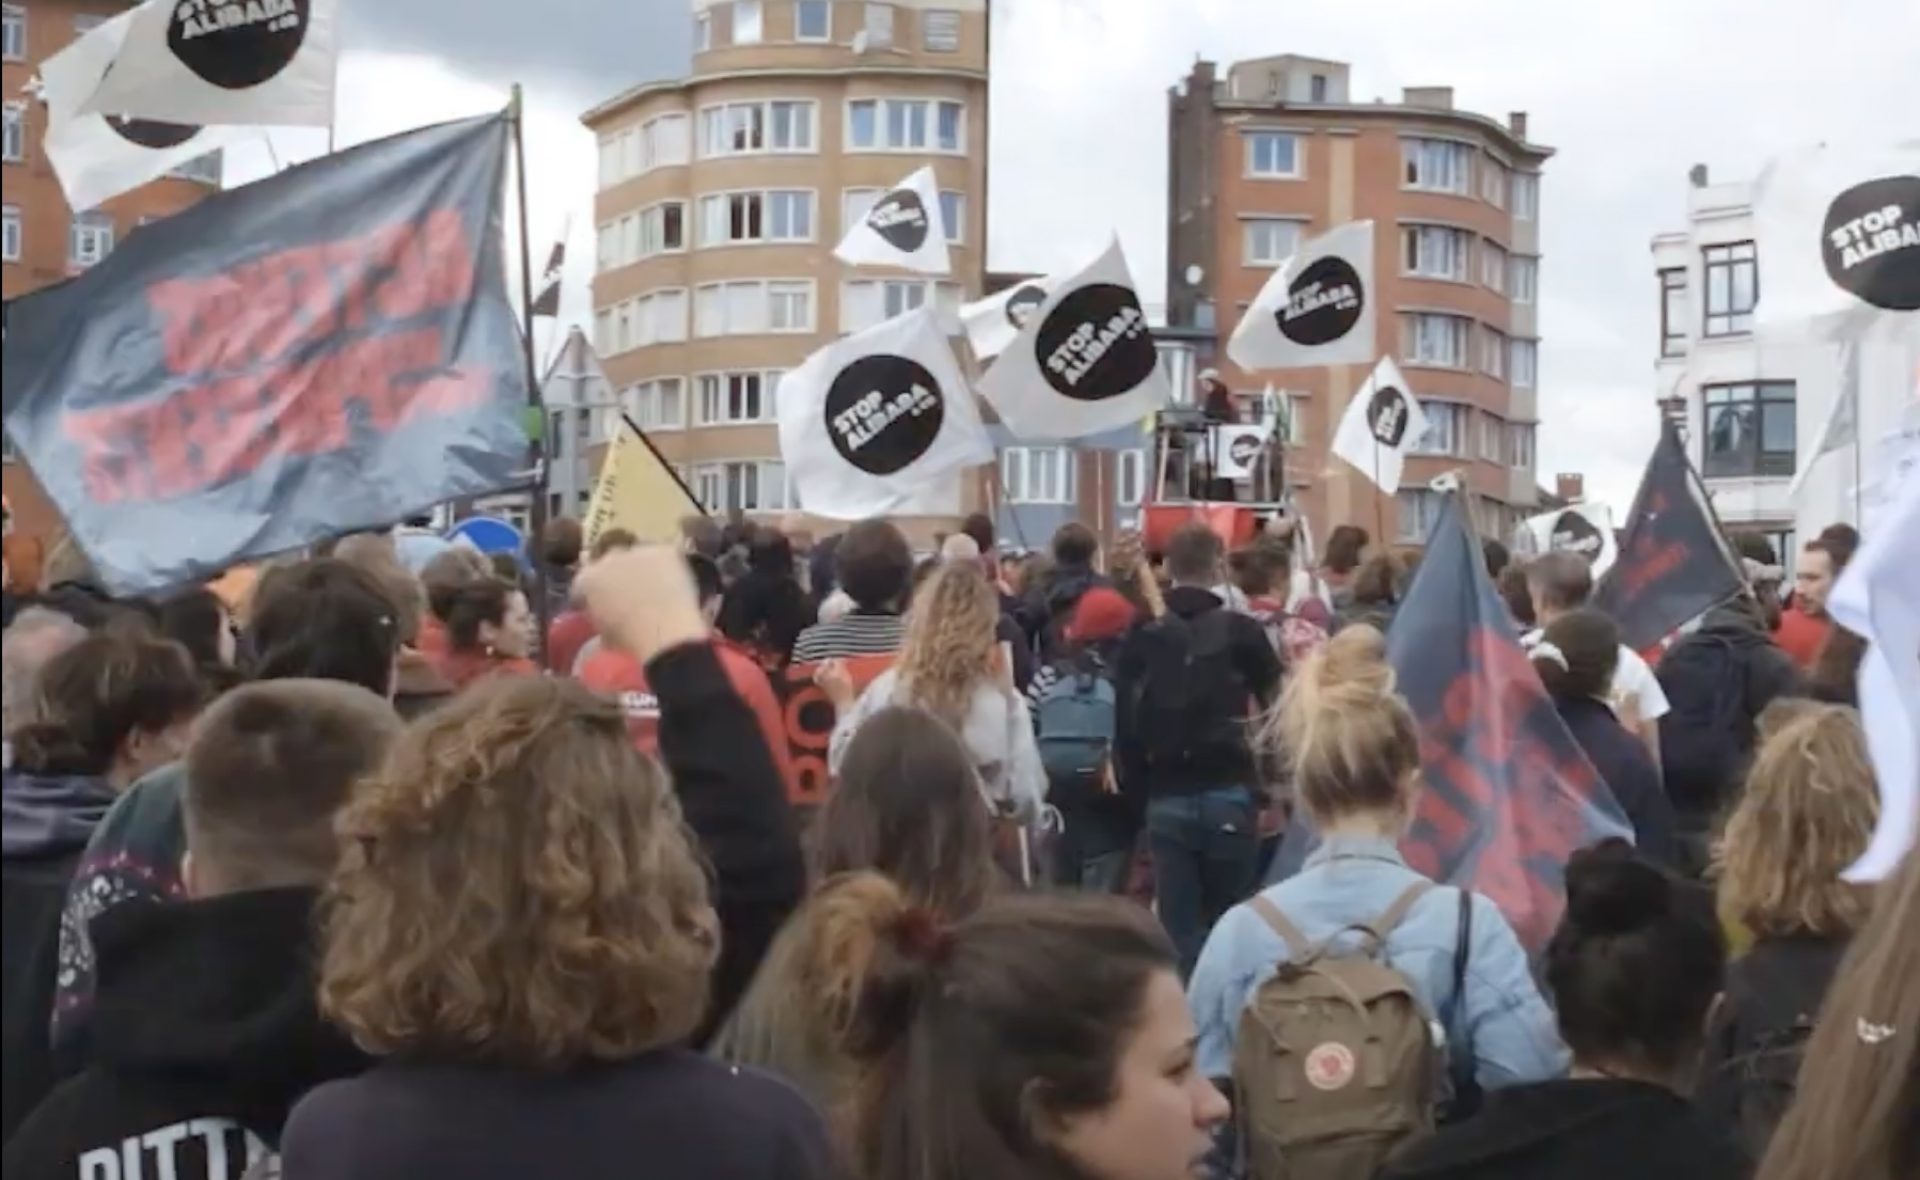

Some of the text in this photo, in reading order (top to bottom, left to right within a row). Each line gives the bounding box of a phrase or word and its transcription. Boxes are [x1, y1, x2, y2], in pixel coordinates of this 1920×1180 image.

[1831, 203, 1903, 249] STOP
[1842, 220, 1920, 270] ALIBA
[1046, 321, 1095, 374] STOP
[1064, 306, 1141, 385] ALIBABA
[833, 390, 883, 434] STOP
[846, 383, 929, 452] ALIBABA
